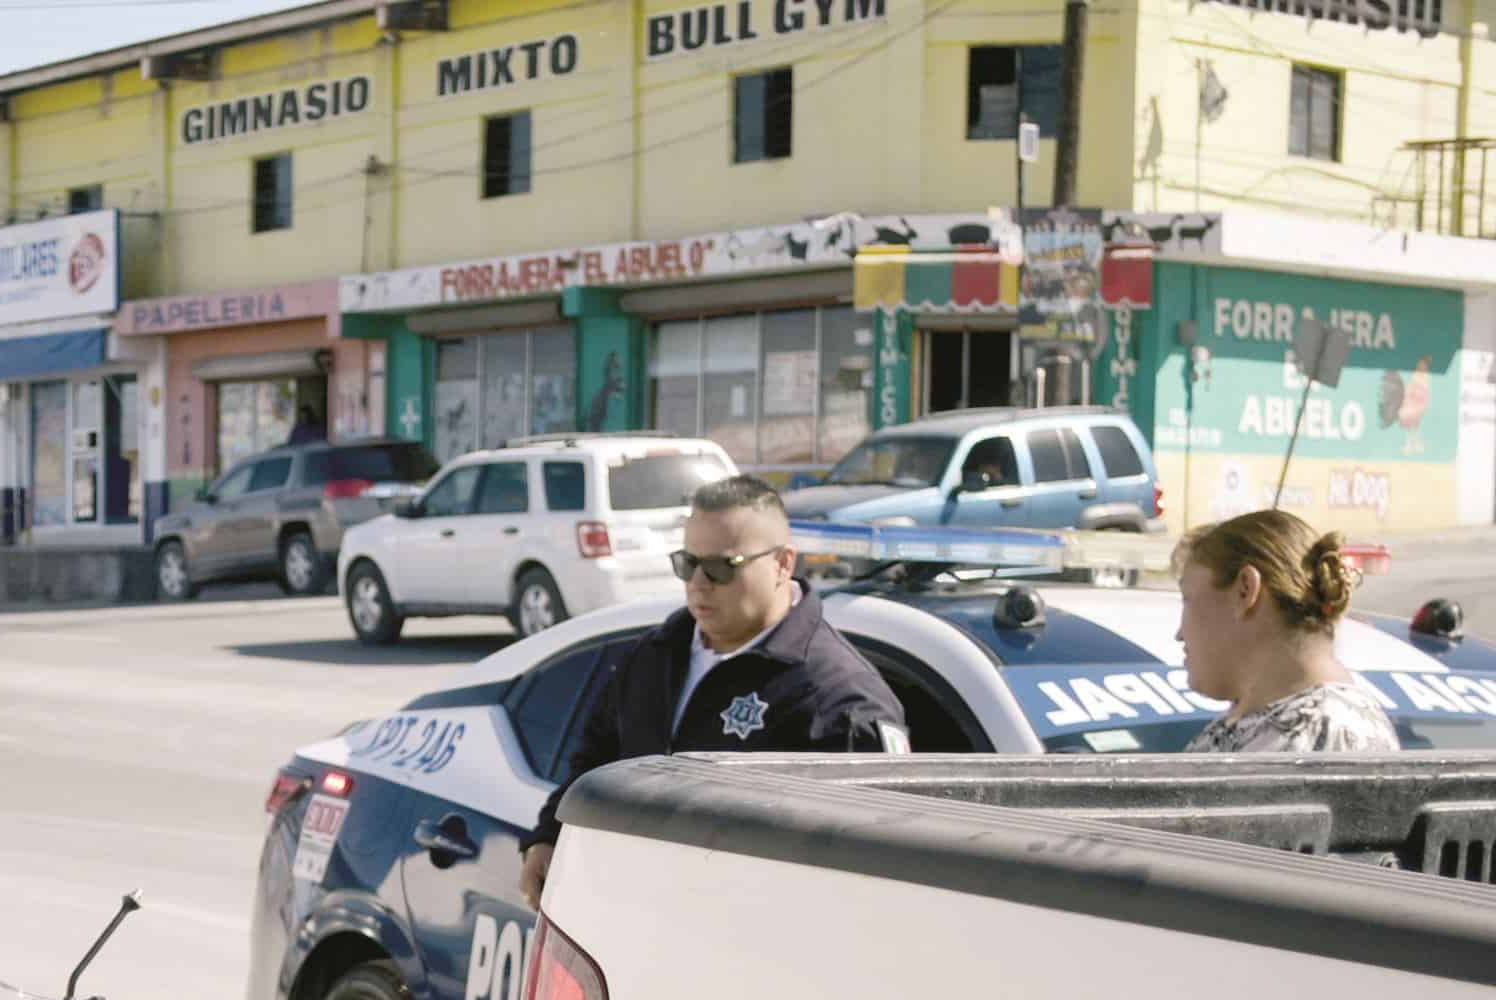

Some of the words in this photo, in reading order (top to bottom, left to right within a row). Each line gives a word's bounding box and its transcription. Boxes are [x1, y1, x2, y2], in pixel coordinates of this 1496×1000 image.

[647, 2, 757, 57] BULL
[438, 34, 577, 96] MIXTO
[183, 76, 370, 143] GIMNASIO
[441, 255, 564, 301] FORRAJERA
[133, 293, 284, 329] PAPELERIA
